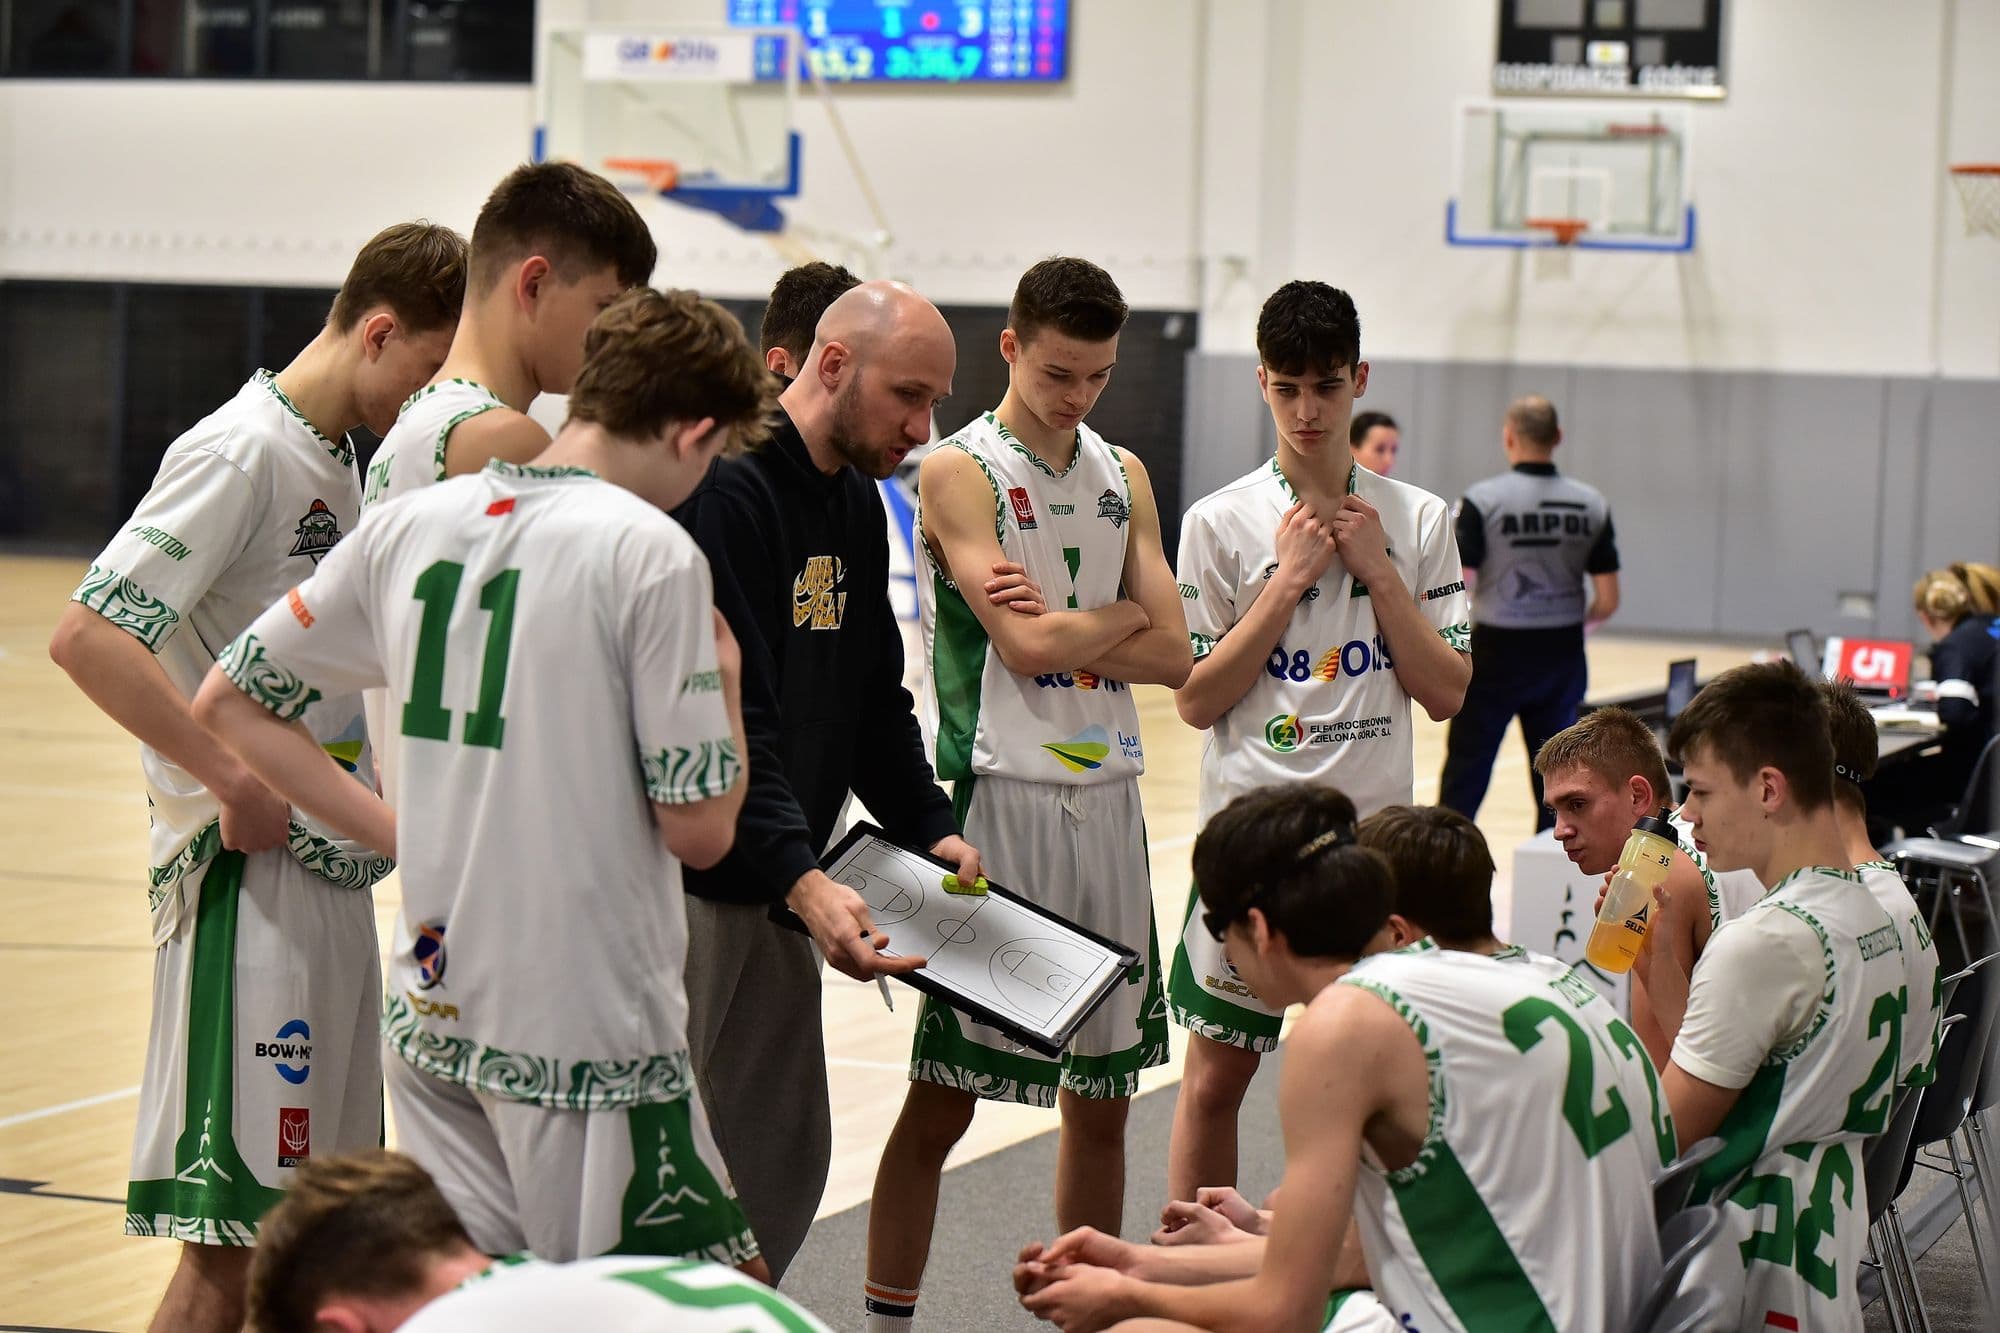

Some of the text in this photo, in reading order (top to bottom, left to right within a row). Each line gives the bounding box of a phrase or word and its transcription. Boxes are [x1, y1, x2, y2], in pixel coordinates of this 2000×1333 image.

[1501, 513, 1592, 537] ARPOL
[136, 526, 192, 561] PROTON
[1178, 583, 1200, 601] TON
[402, 560, 521, 750] 11
[1658, 854, 1671, 867] 35
